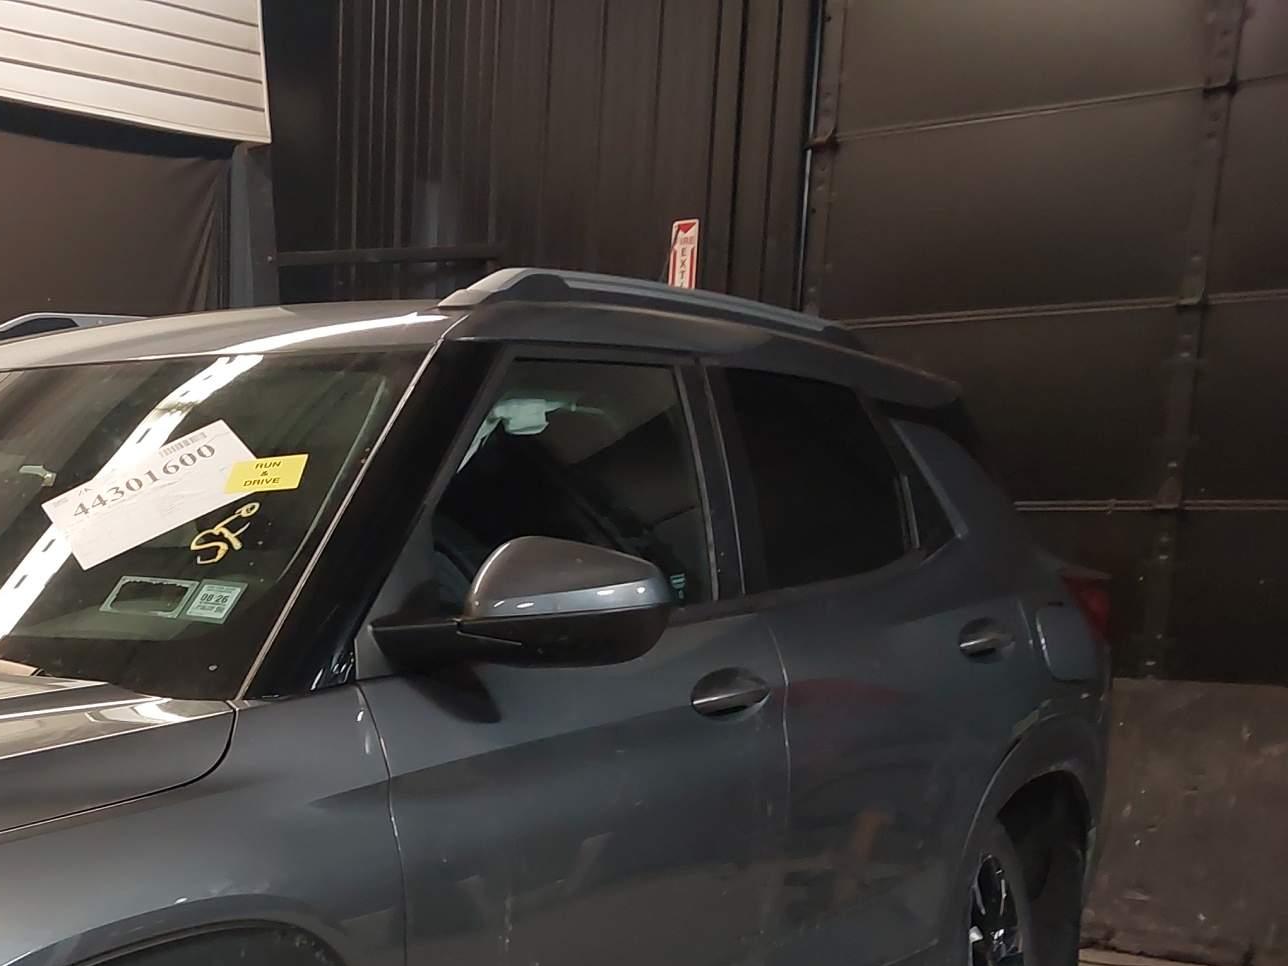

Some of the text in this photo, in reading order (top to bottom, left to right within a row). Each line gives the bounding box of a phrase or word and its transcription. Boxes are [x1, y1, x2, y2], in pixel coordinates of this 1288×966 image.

[255, 460, 282, 470] RUN
[72, 443, 216, 517] 44301600
[242, 477, 282, 487] DRIVE
